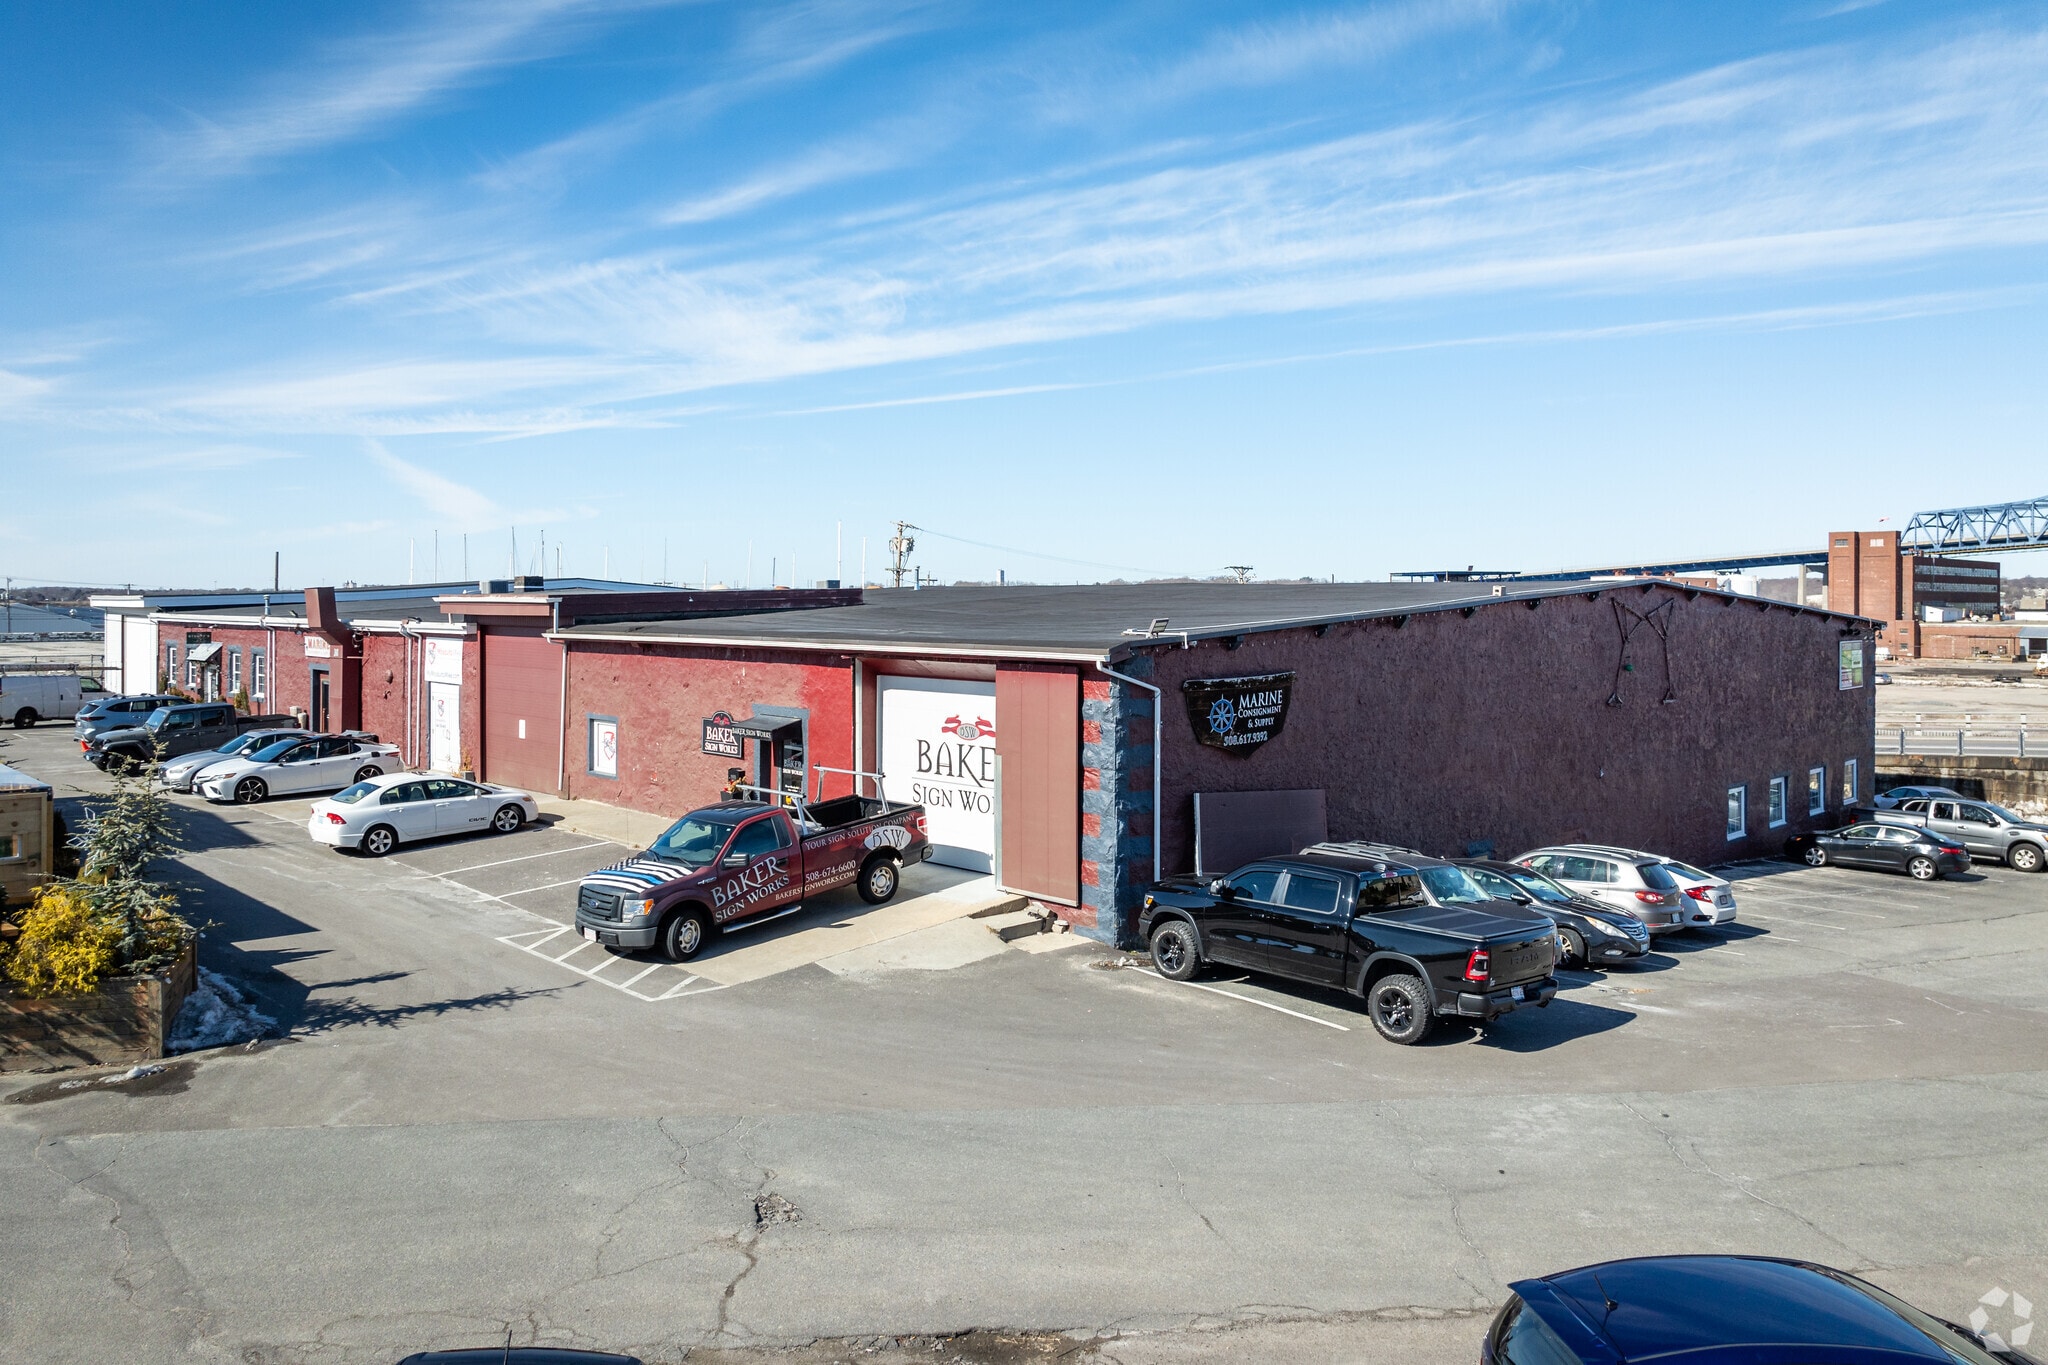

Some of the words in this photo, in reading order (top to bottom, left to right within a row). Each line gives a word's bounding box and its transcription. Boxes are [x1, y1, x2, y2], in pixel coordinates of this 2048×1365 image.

[1239, 690, 1283, 709] MARINE
[1237, 705, 1282, 718] CONSIGNMENT
[1247, 719, 1253, 728] &
[1254, 717, 1275, 728] SUPPLY
[706, 726, 738, 746] BAKER
[704, 742, 718, 752] SIGN
[719, 743, 738, 754] WORKS
[912, 783, 952, 808] SIGN
[958, 789, 994, 815] WO
[805, 840, 827, 851] YOUR
[828, 834, 845, 846] SIGN
[847, 823, 880, 840] SOLUTION
[883, 813, 915, 827] COMPANY
[872, 829, 905, 848] BSW
[711, 856, 787, 908] BAKER
[805, 860, 857, 883] 508-674-6600
[775, 870, 856, 900] BAKERSIGNWORKS.COM
[715, 898, 745, 923] SIGN
[746, 874, 790, 904] WORKS
